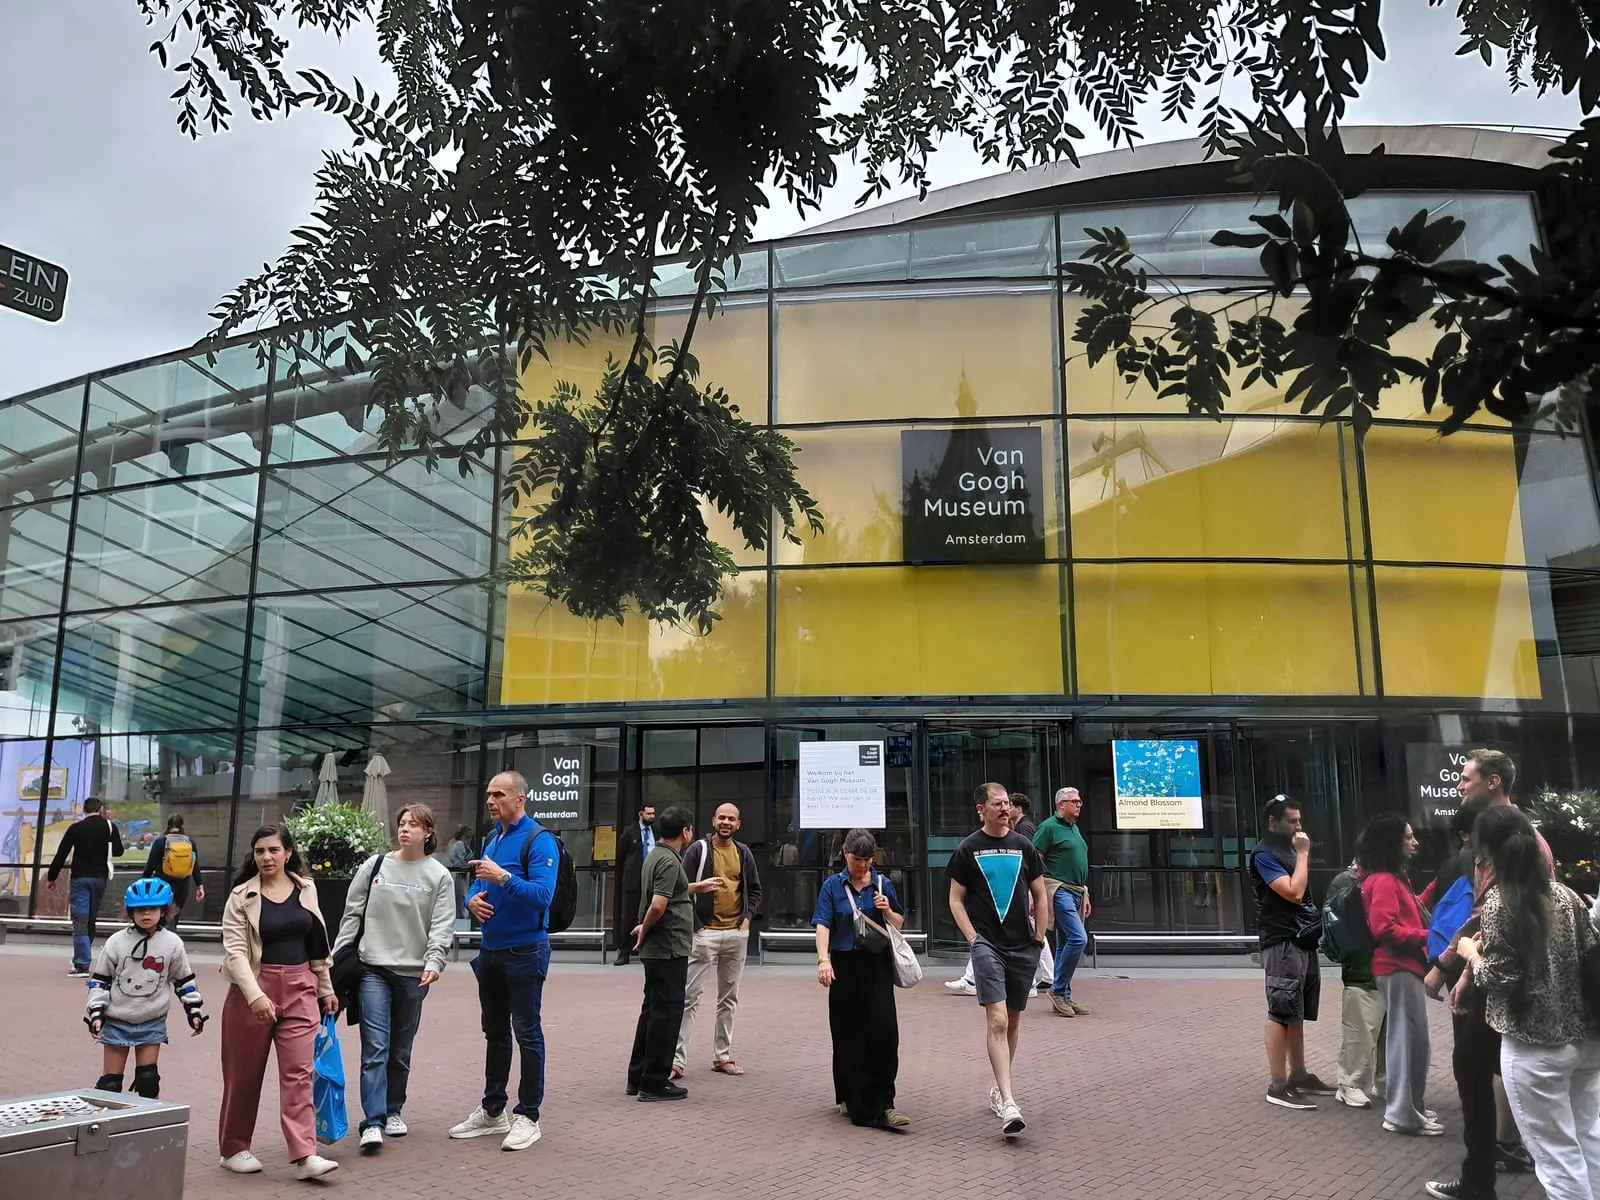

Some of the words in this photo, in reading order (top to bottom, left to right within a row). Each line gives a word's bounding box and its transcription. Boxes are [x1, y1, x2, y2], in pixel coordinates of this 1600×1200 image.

[12, 286, 55, 312] ZUID
[976, 446, 1024, 466] Van
[958, 470, 1025, 494] Gogh
[924, 498, 1026, 518] Museum
[945, 532, 1026, 545] Amsterdam
[553, 757, 580, 770] Van
[1448, 752, 1468, 766] Va
[542, 772, 579, 787] Gogh
[1439, 768, 1462, 782] Go
[533, 811, 578, 819] Amsterdam
